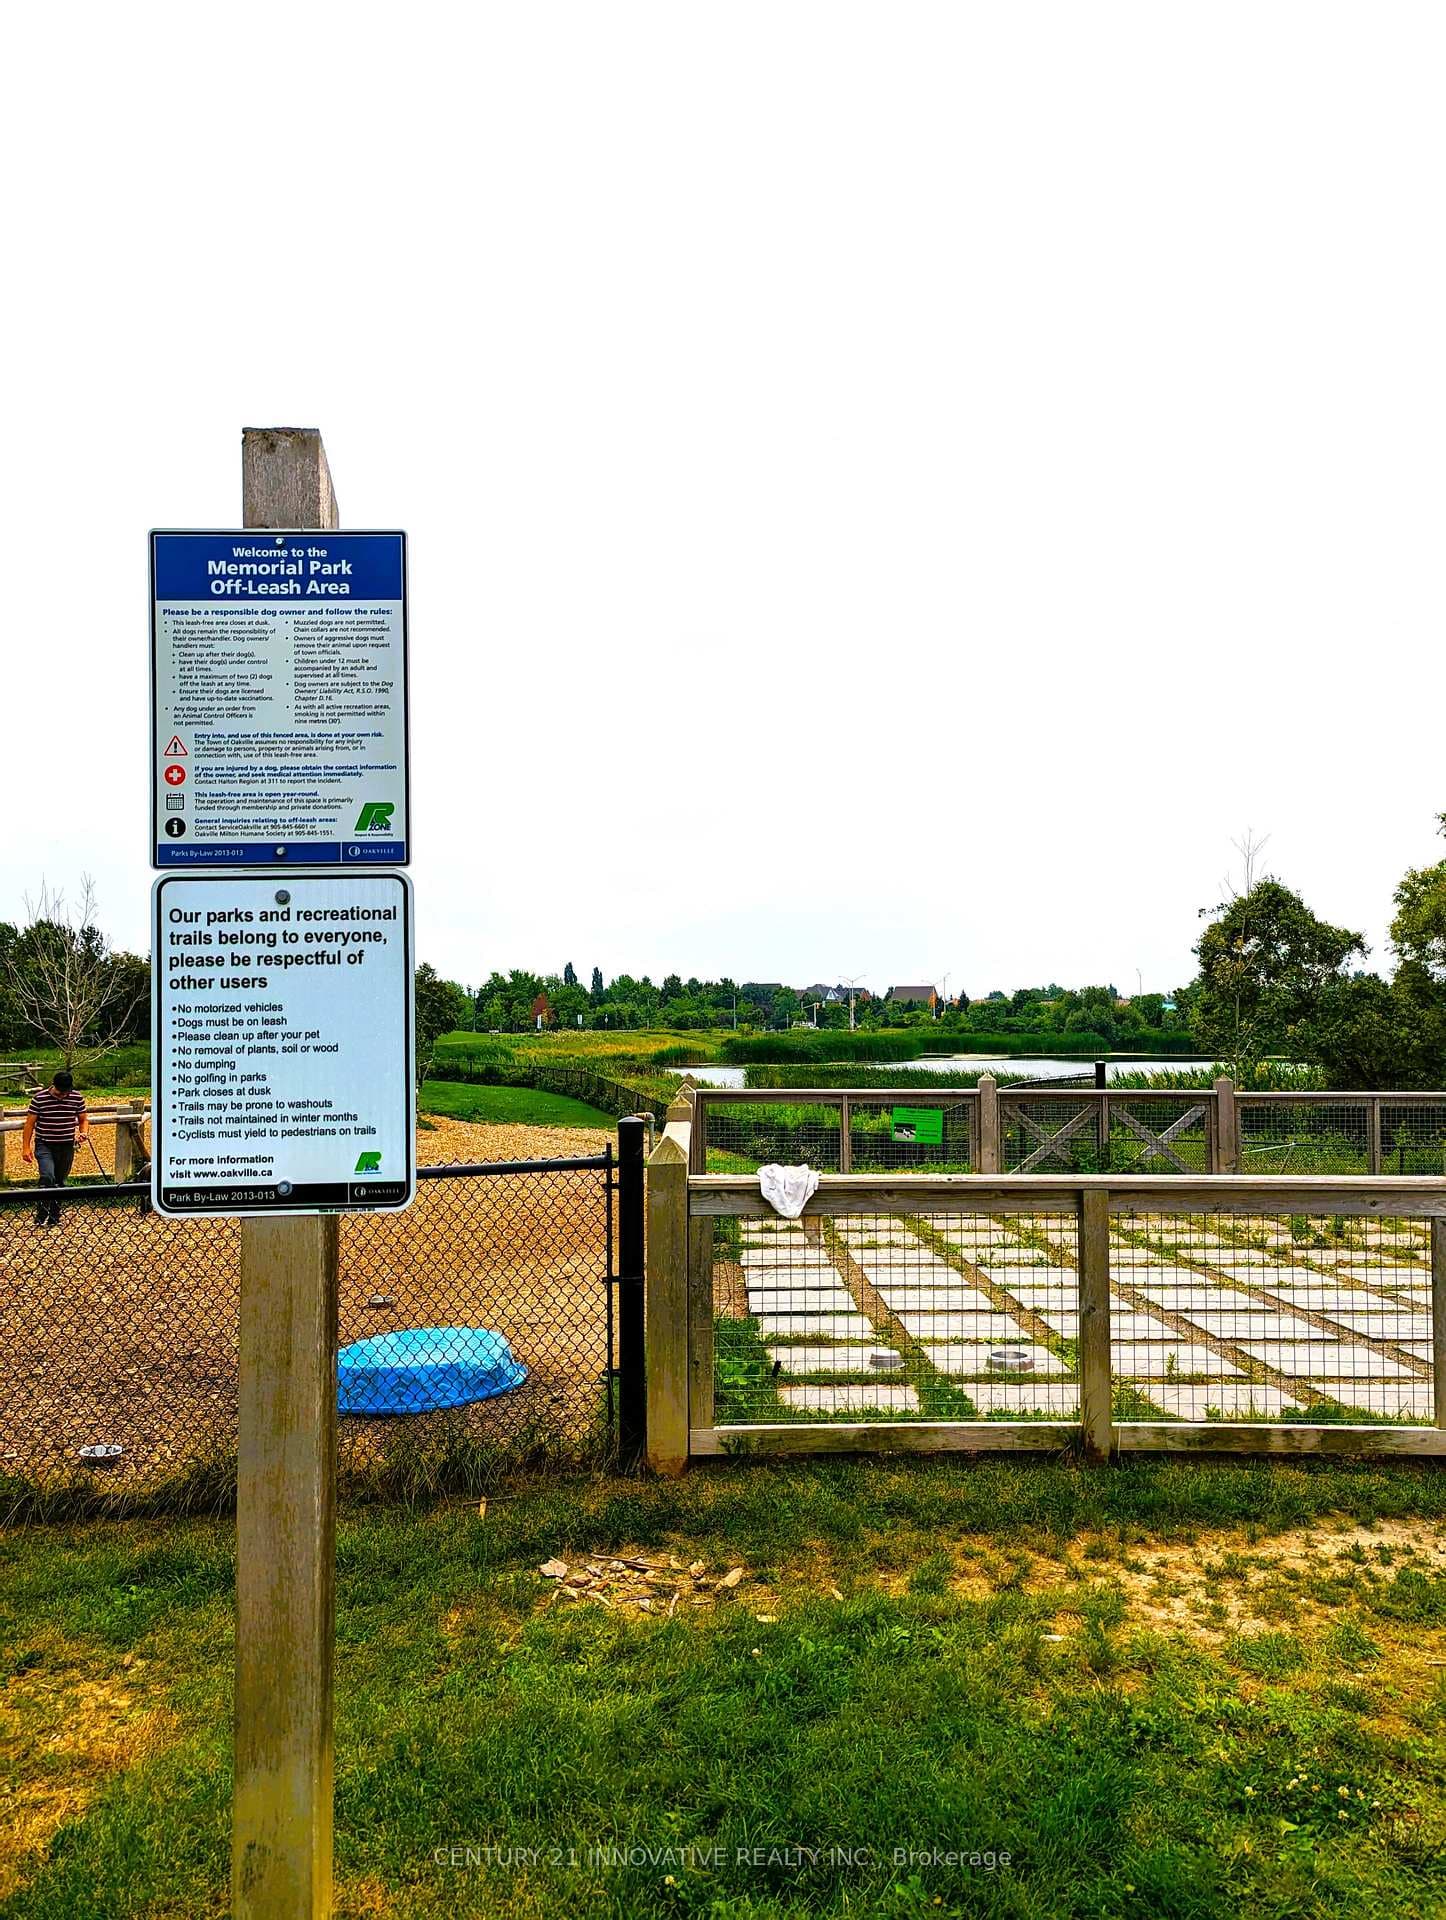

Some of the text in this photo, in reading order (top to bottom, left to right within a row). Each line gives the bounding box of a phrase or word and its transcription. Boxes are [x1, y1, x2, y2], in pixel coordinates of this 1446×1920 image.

[232, 547, 327, 557] Welcome to the
[208, 559, 352, 575] Memorial Park
[211, 579, 350, 594] Off-Leash Area
[211, 608, 259, 616] responsible
[169, 906, 396, 926] Our parks and recreational
[169, 930, 387, 947] trails belong to everyone,
[169, 950, 364, 971] please be respectful of
[170, 974, 268, 990] other users
[178, 1002, 283, 1013] No motorized vehicles
[178, 1017, 203, 1029] Dogs
[206, 1017, 229, 1027] must
[232, 1017, 244, 1027] be
[261, 1016, 287, 1026] leash
[178, 1030, 320, 1042] Please clean up after your pet
[178, 1046, 192, 1055] No
[194, 1045, 233, 1055] removal
[236, 1044, 245, 1054] of
[248, 1044, 279, 1055] plants,
[282, 1043, 298, 1054] soil
[313, 1043, 339, 1053] wood
[178, 1059, 236, 1070] No dumping
[178, 1072, 267, 1084] No golfing in parks
[178, 1086, 271, 1098] Park closes at dusk
[178, 1098, 333, 1112] Trails may be prone to washouts
[178, 1112, 358, 1125] Trails not maintained in winter months
[178, 1129, 215, 1140] Cyclists
[218, 1129, 242, 1138] must
[244, 1128, 266, 1139] yield
[269, 1128, 278, 1137] to
[281, 1126, 336, 1138] pedestrians
[354, 1125, 376, 1135] trails
[170, 1156, 187, 1165] For
[217, 1154, 274, 1164] information
[170, 1168, 272, 1179] visit www.oakville.ca
[170, 1191, 275, 1203] Park By-Law 2013-013
